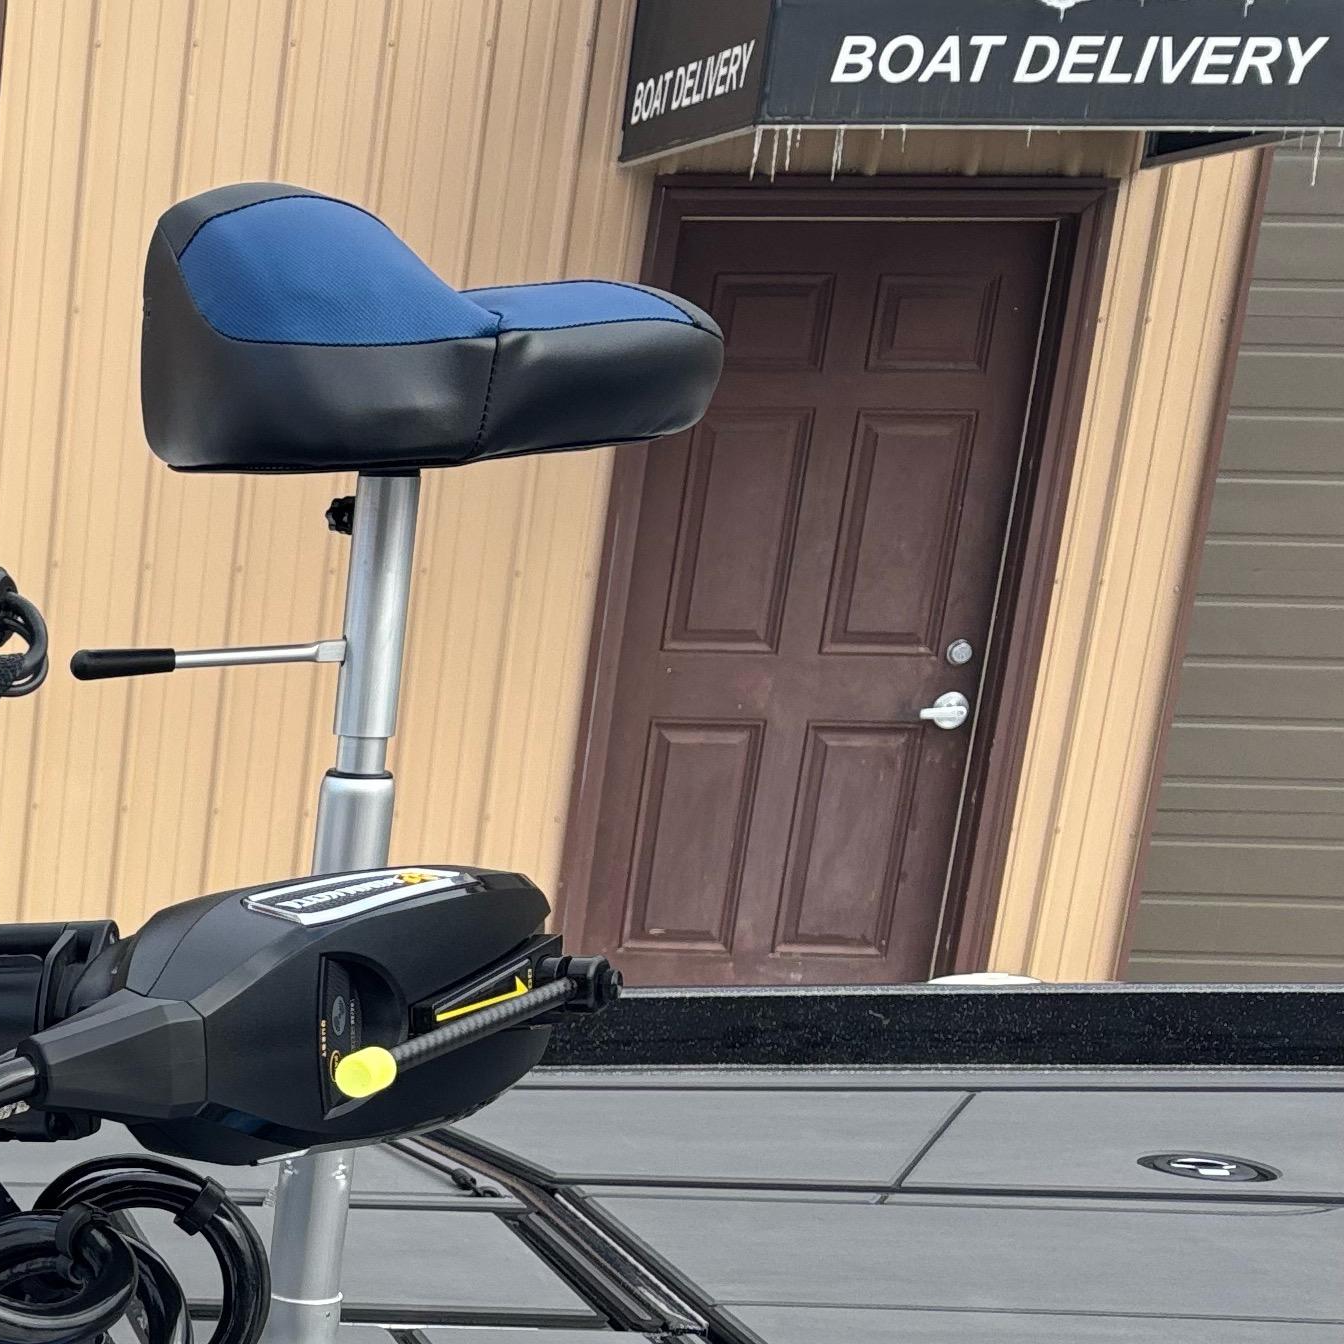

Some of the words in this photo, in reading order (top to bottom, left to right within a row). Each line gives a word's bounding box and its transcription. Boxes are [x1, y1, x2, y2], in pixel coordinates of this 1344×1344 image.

[630, 75, 670, 125] BOAT
[670, 40, 755, 111] DELIVERY
[830, 34, 1007, 84] BOAT
[1013, 34, 1330, 85] DELIVERY
